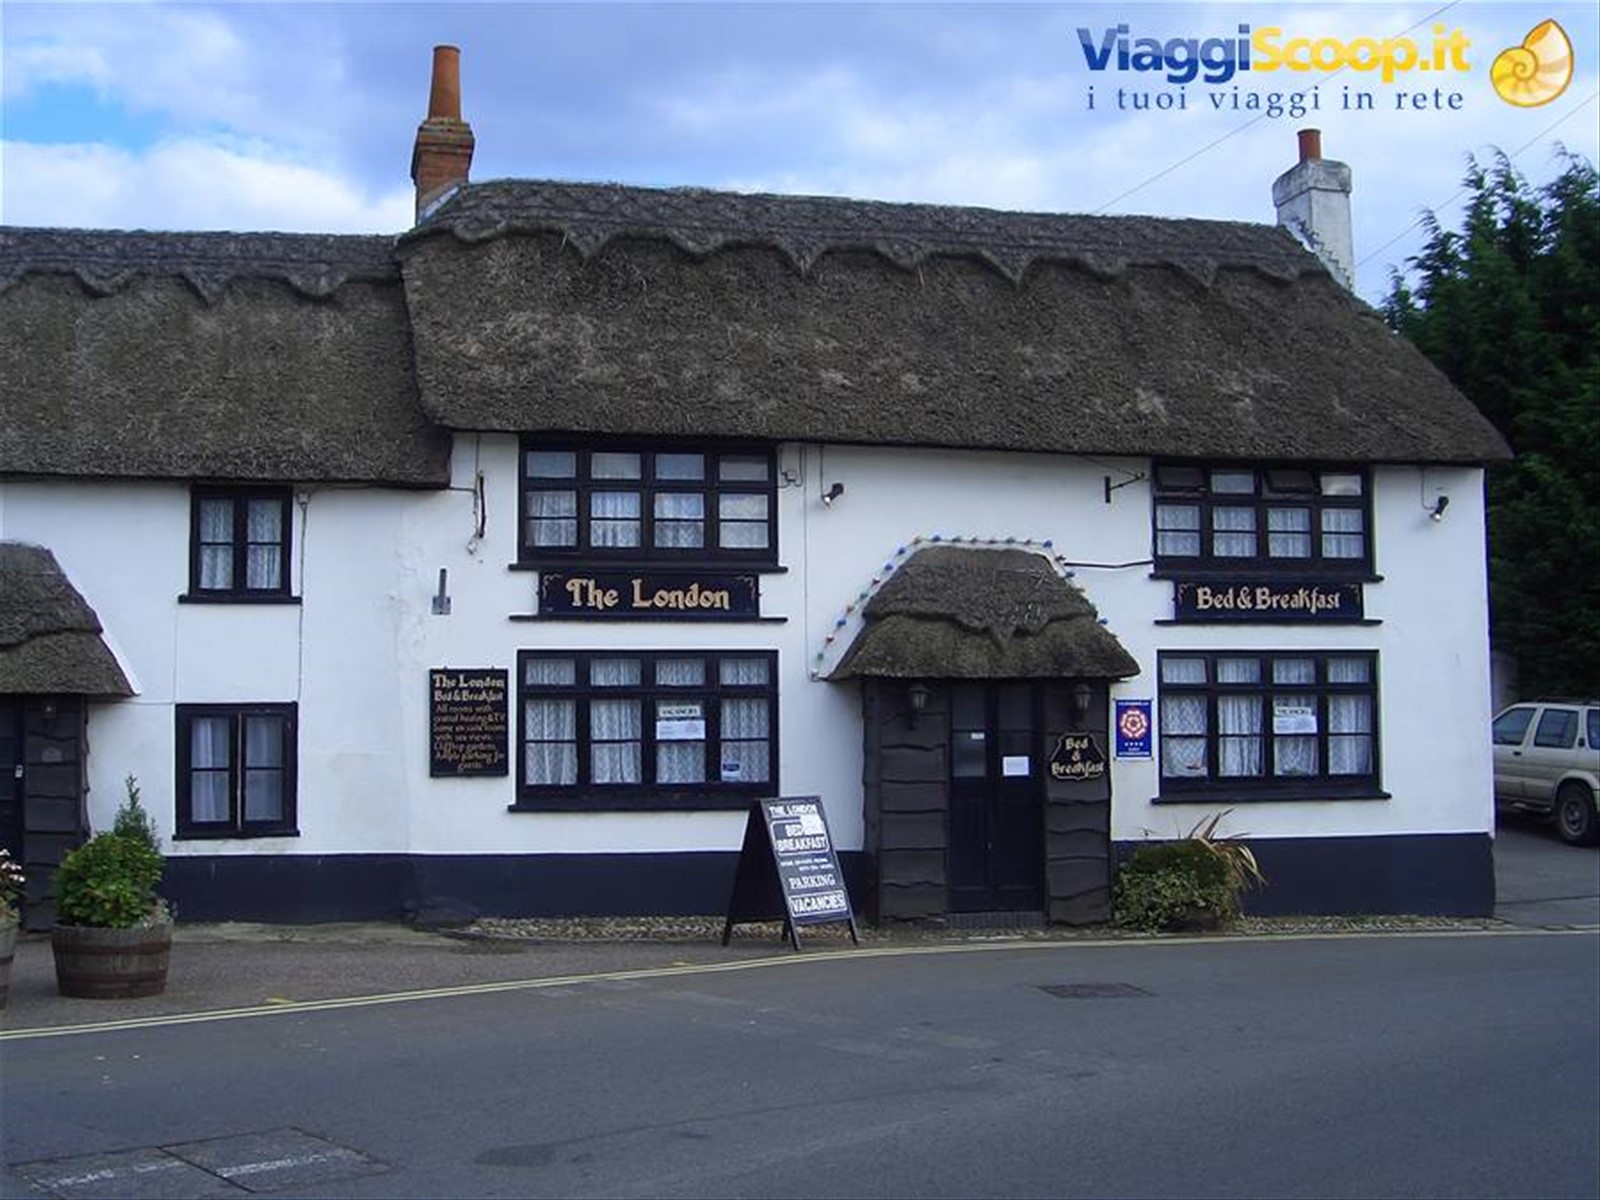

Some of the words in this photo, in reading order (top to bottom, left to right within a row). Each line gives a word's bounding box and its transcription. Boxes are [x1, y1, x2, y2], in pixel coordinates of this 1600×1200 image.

[565, 578, 619, 610] The
[631, 578, 730, 610] London
[1196, 586, 1235, 610] Bed
[1236, 586, 1253, 610] &
[1254, 586, 1341, 614] Breakfast
[433, 674, 456, 688] The
[458, 674, 505, 689] London
[1065, 738, 1089, 750] Bed
[1051, 761, 1105, 777] Breakfast
[776, 837, 826, 851] BREAKFAST
[788, 873, 836, 889] PARKING
[791, 893, 846, 913] VACANCIES
